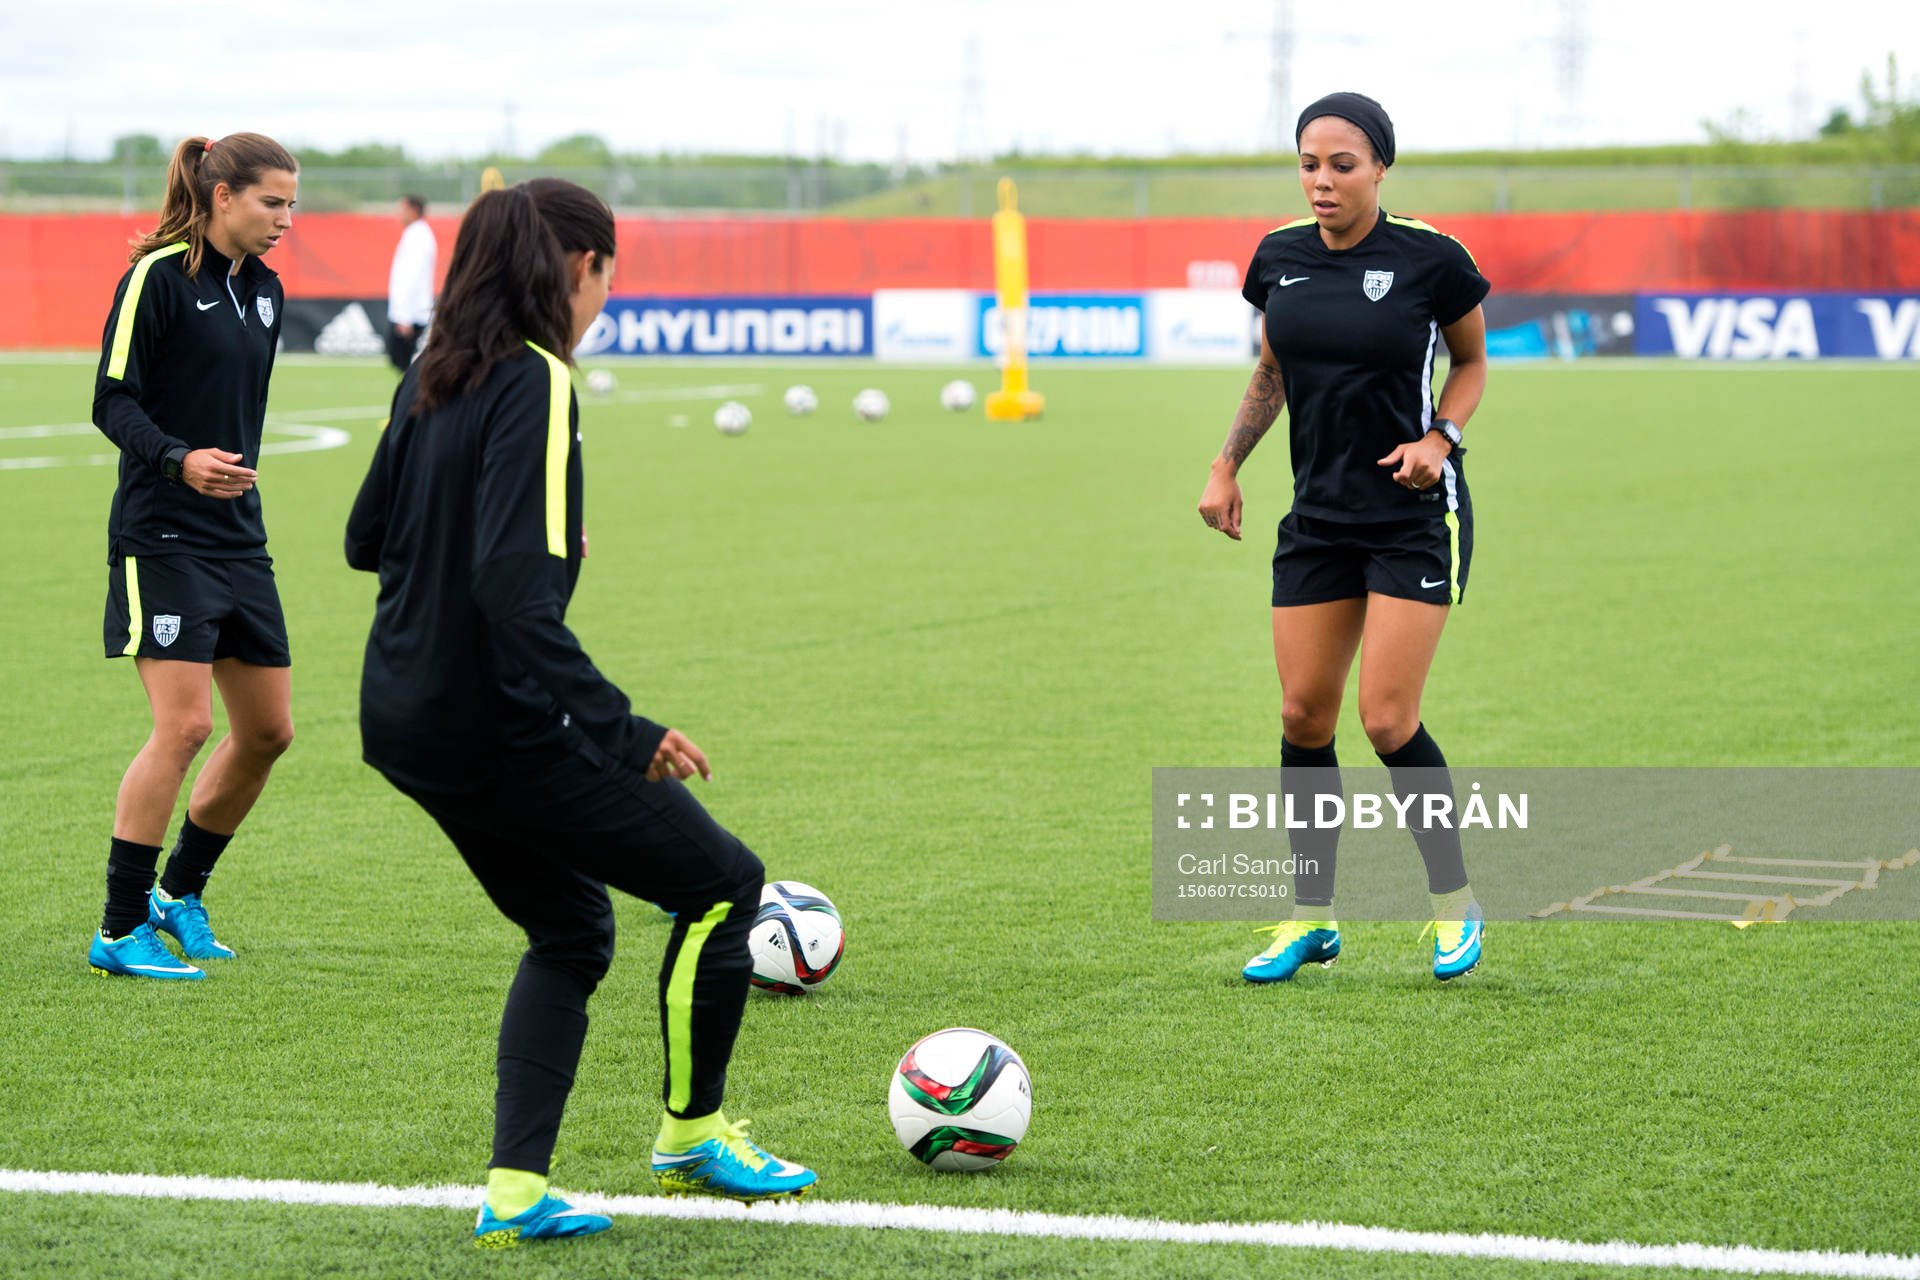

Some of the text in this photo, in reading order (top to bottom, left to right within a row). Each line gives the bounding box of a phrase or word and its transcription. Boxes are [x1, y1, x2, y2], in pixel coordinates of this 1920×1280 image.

[619, 309, 864, 352] HYUNDAI
[984, 306, 1141, 354] GZPROM
[1655, 298, 1820, 358] VISA
